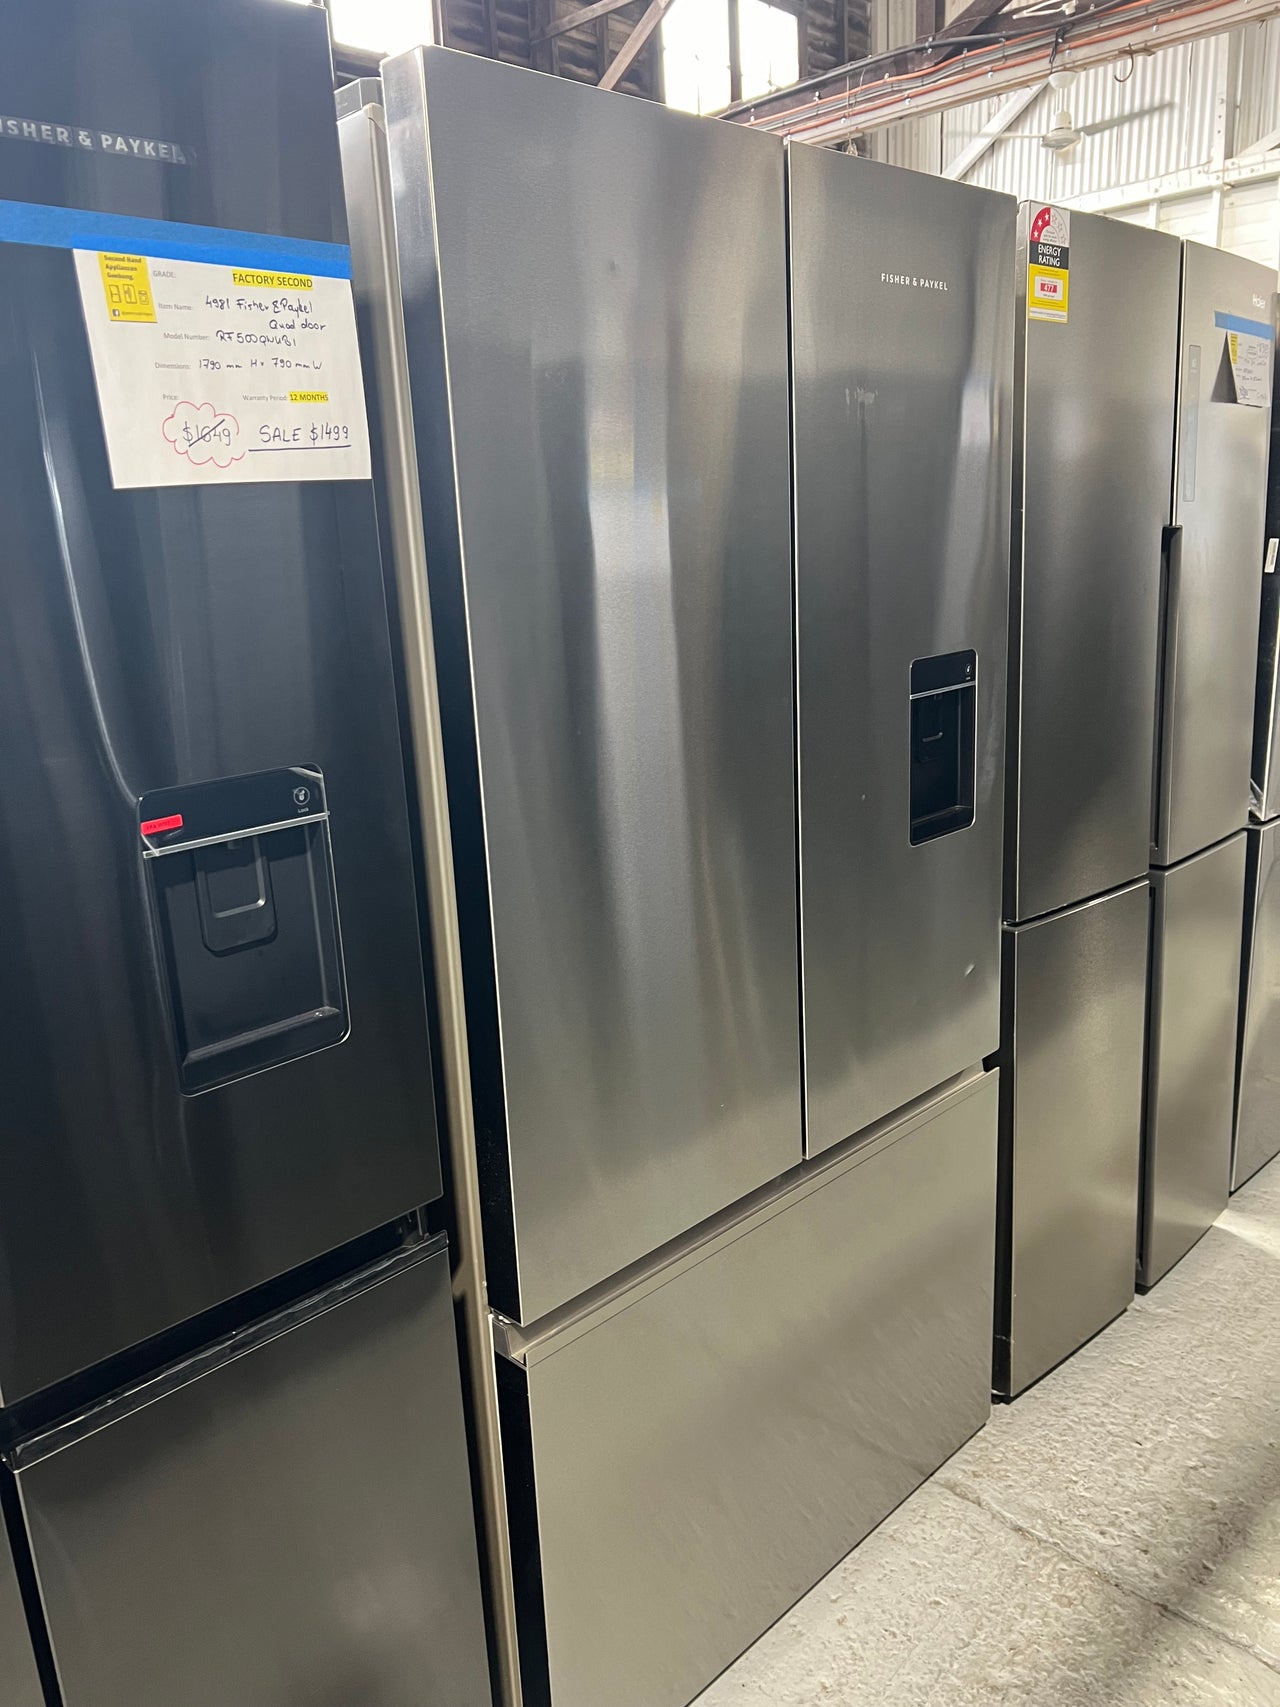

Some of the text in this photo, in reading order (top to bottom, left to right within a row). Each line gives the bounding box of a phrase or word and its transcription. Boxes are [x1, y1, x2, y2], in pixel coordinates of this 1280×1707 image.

[78, 130, 92, 147] &
[1038, 243, 1062, 257] ENERGY
[1038, 254, 1061, 267] RATING
[233, 273, 313, 288] FACTORY SECOND
[881, 272, 948, 291] FISHER & PAYKEL
[205, 295, 230, 310] 4981
[236, 298, 270, 312] Fisher
[268, 318, 327, 331] Quad door
[199, 358, 222, 371] 1790
[250, 359, 258, 367] H
[271, 357, 292, 369] 790
[290, 393, 298, 401] 12
[299, 393, 329, 402] MONTHS
[259, 421, 350, 446] SALE $1499
